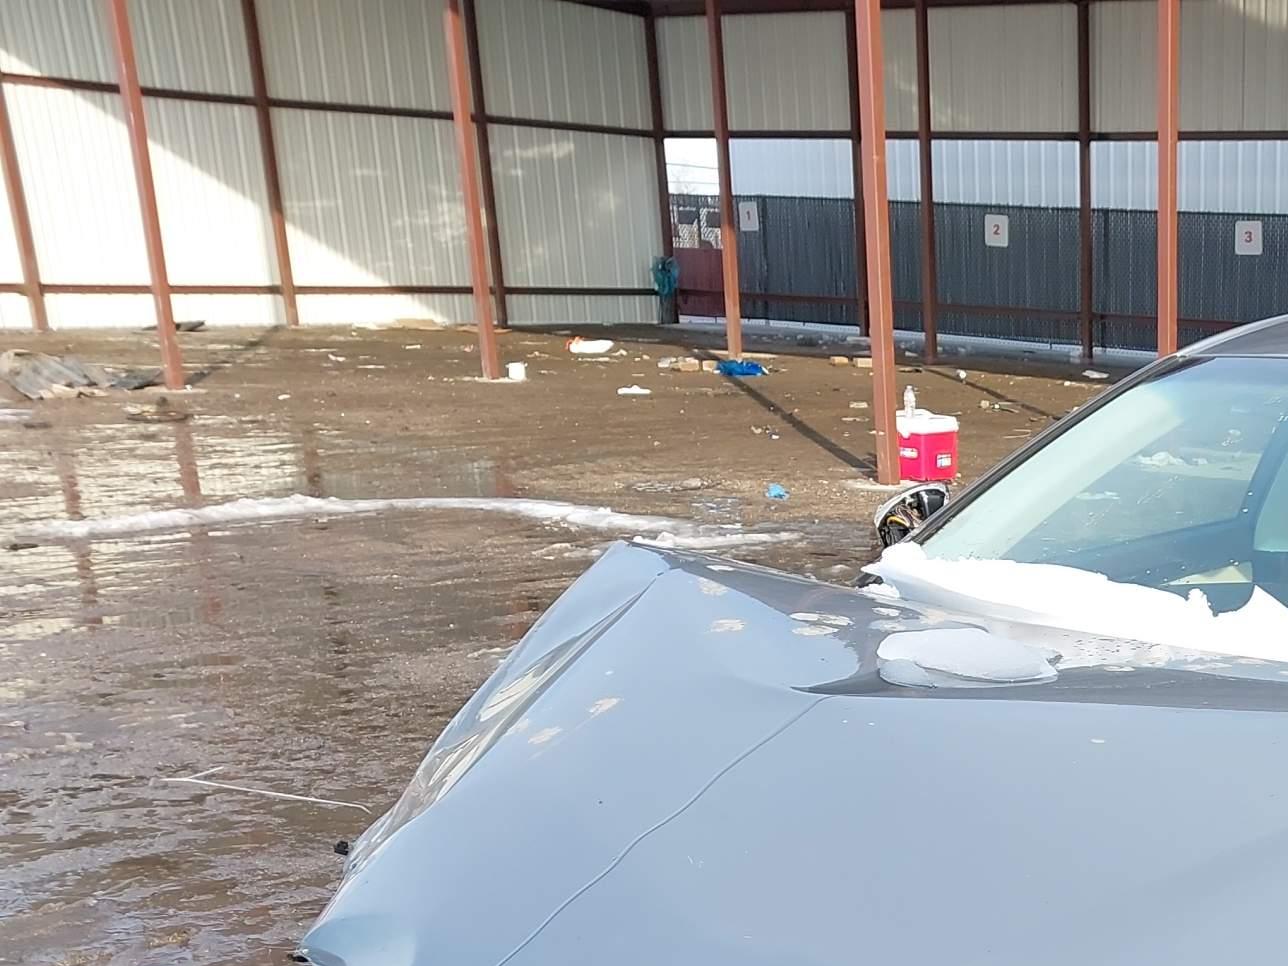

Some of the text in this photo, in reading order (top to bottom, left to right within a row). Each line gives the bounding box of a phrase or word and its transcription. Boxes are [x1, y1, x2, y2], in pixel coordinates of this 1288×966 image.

[745, 210, 752, 221] 1
[993, 223, 1001, 235] 2
[1244, 231, 1253, 243] 3
